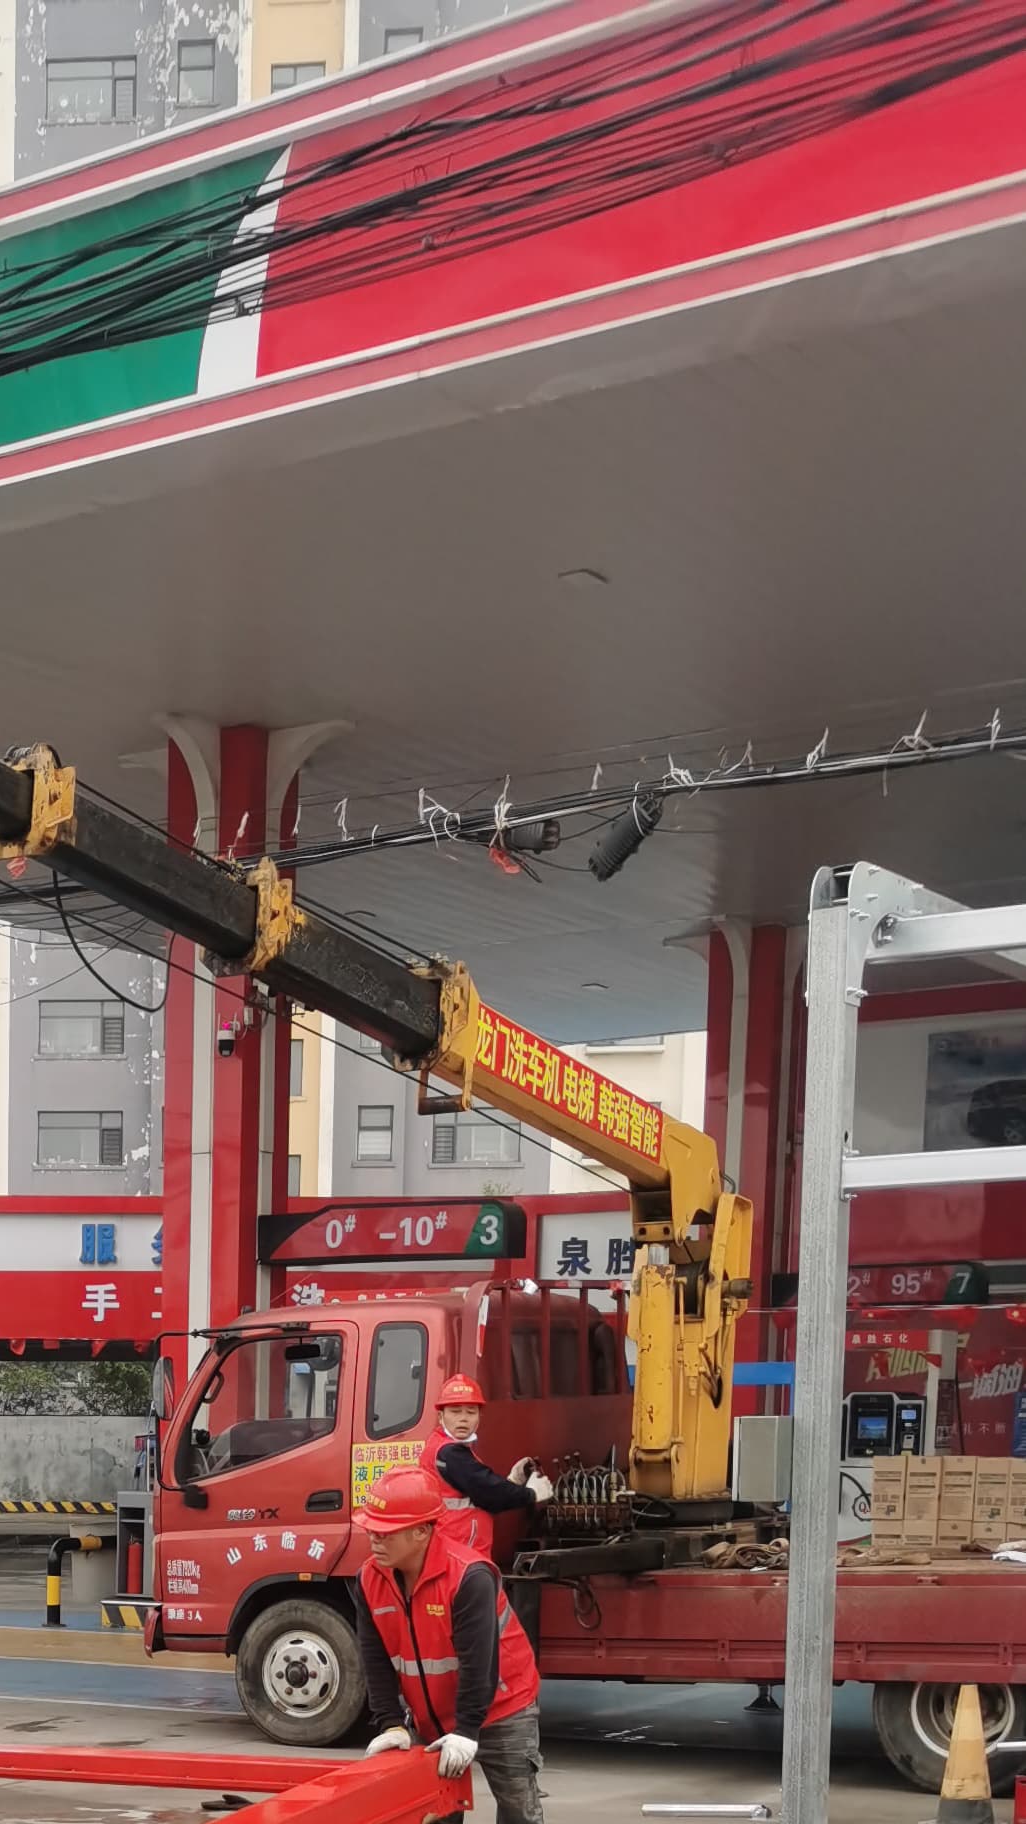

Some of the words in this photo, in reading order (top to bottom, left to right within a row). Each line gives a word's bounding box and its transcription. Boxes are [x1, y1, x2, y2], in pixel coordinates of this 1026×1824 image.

[474, 1008, 560, 1105] 龙门洗车机
[562, 1060, 595, 1124] 电梯
[598, 1080, 660, 1158] 韩强智能
[325, 1214, 356, 1249] 0#
[480, 1215, 498, 1245] 3
[847, 1272, 871, 1297] 2#
[891, 1269, 932, 1295] 95#
[956, 1272, 971, 1294] 7
[354, 1444, 423, 1463] 临沂韩强电梯
[226, 1531, 325, 1565] 山东临沂
